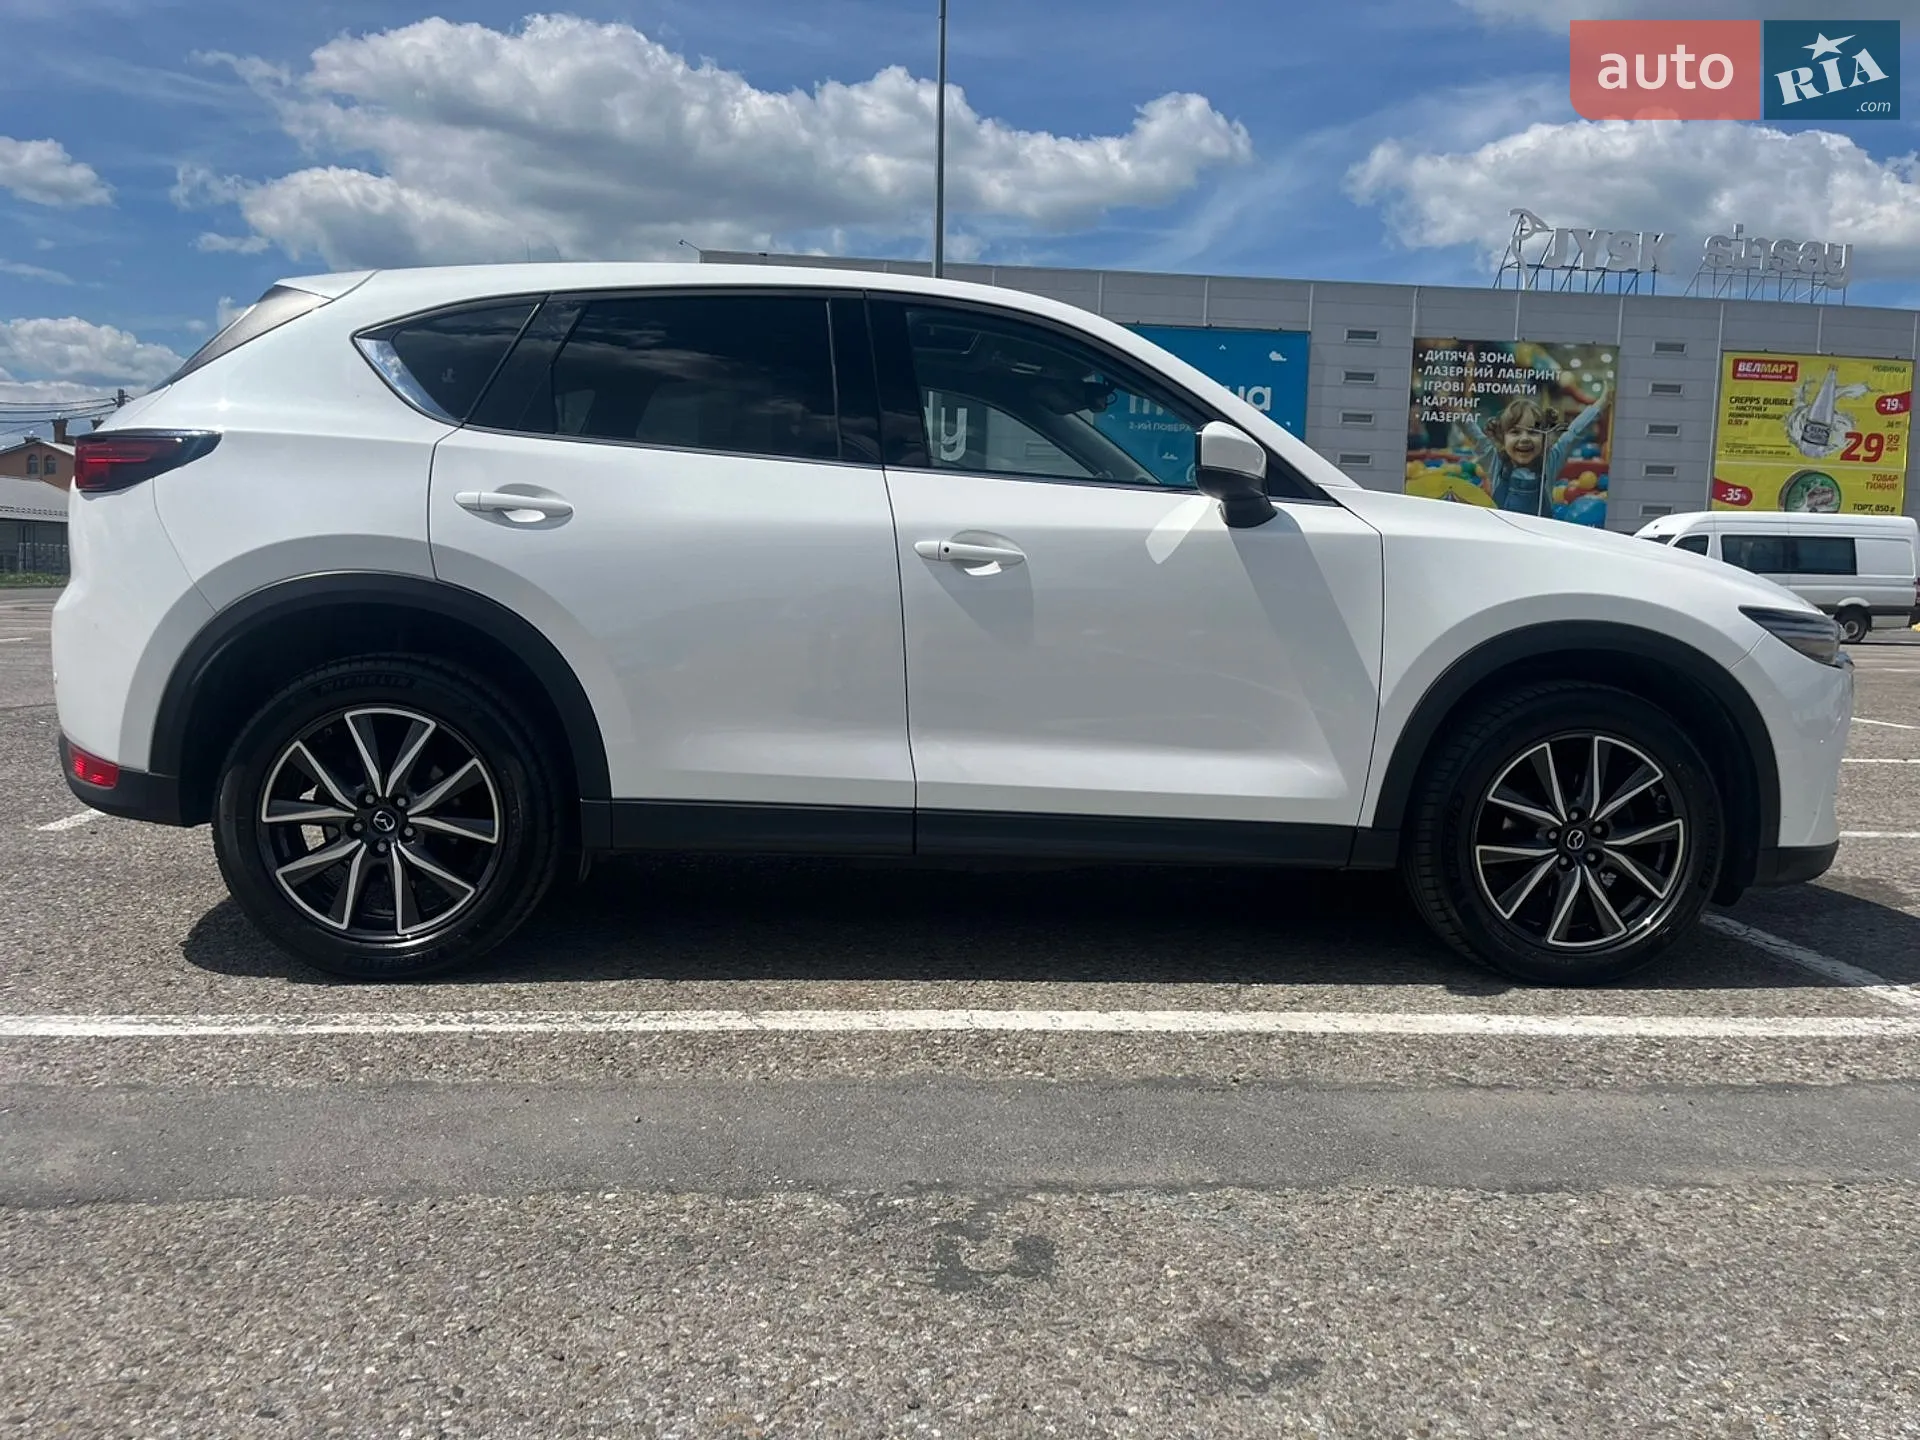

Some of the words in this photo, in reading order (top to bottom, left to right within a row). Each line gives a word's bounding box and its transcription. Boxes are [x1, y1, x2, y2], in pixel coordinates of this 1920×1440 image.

[1541, 228, 1676, 274] JYSK
[1702, 223, 1853, 290] sinsay
[1424, 350, 1475, 363] ДИТЯЧА
[1479, 353, 1515, 364] ЗОНА
[1424, 365, 1494, 379] ЛАЗЕРНИЙ
[1498, 368, 1561, 381] ЛАБІРИНТ
[1738, 361, 1795, 374] ВЕЛМАРТ
[1423, 381, 1464, 392] ІГРОВІ
[1468, 383, 1537, 395] АВТОМАТИ
[1422, 396, 1480, 407] КАРТИНГ
[1729, 396, 1761, 405] CREPPS
[1421, 411, 1480, 423] ЛАЗЕРТАГ
[1840, 432, 1884, 462] 29
[1887, 434, 1900, 444] 99
